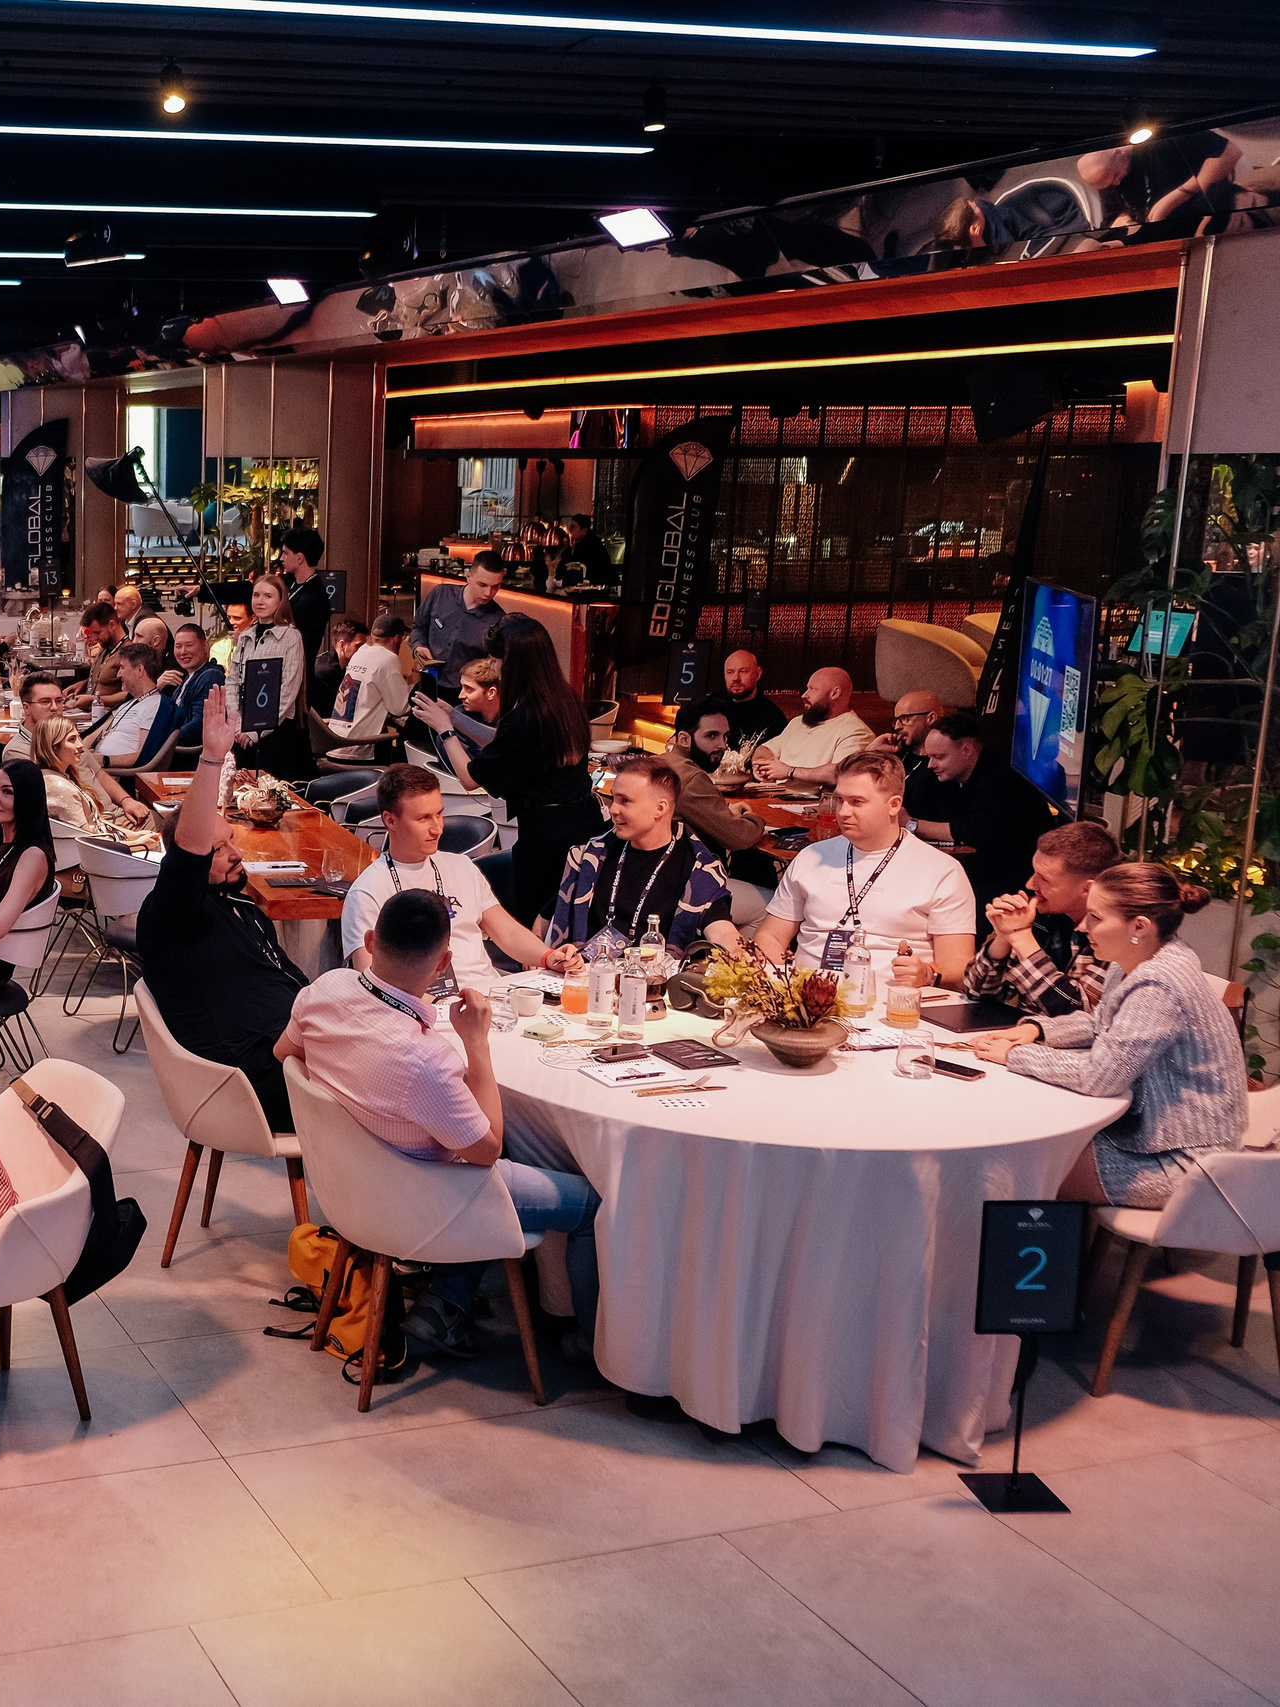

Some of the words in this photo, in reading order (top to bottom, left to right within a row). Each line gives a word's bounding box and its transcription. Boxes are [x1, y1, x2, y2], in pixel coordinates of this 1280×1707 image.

[45, 484, 53, 521] CLUB
[43, 570, 58, 586] 13
[649, 492, 687, 637] EDGLOBAL
[671, 550, 696, 641] BUSINESS
[689, 494, 702, 542] CLUB
[325, 584, 336, 600] 9
[680, 661, 695, 685] 5
[256, 683, 269, 708] 6
[1014, 1246, 1048, 1290] 2
